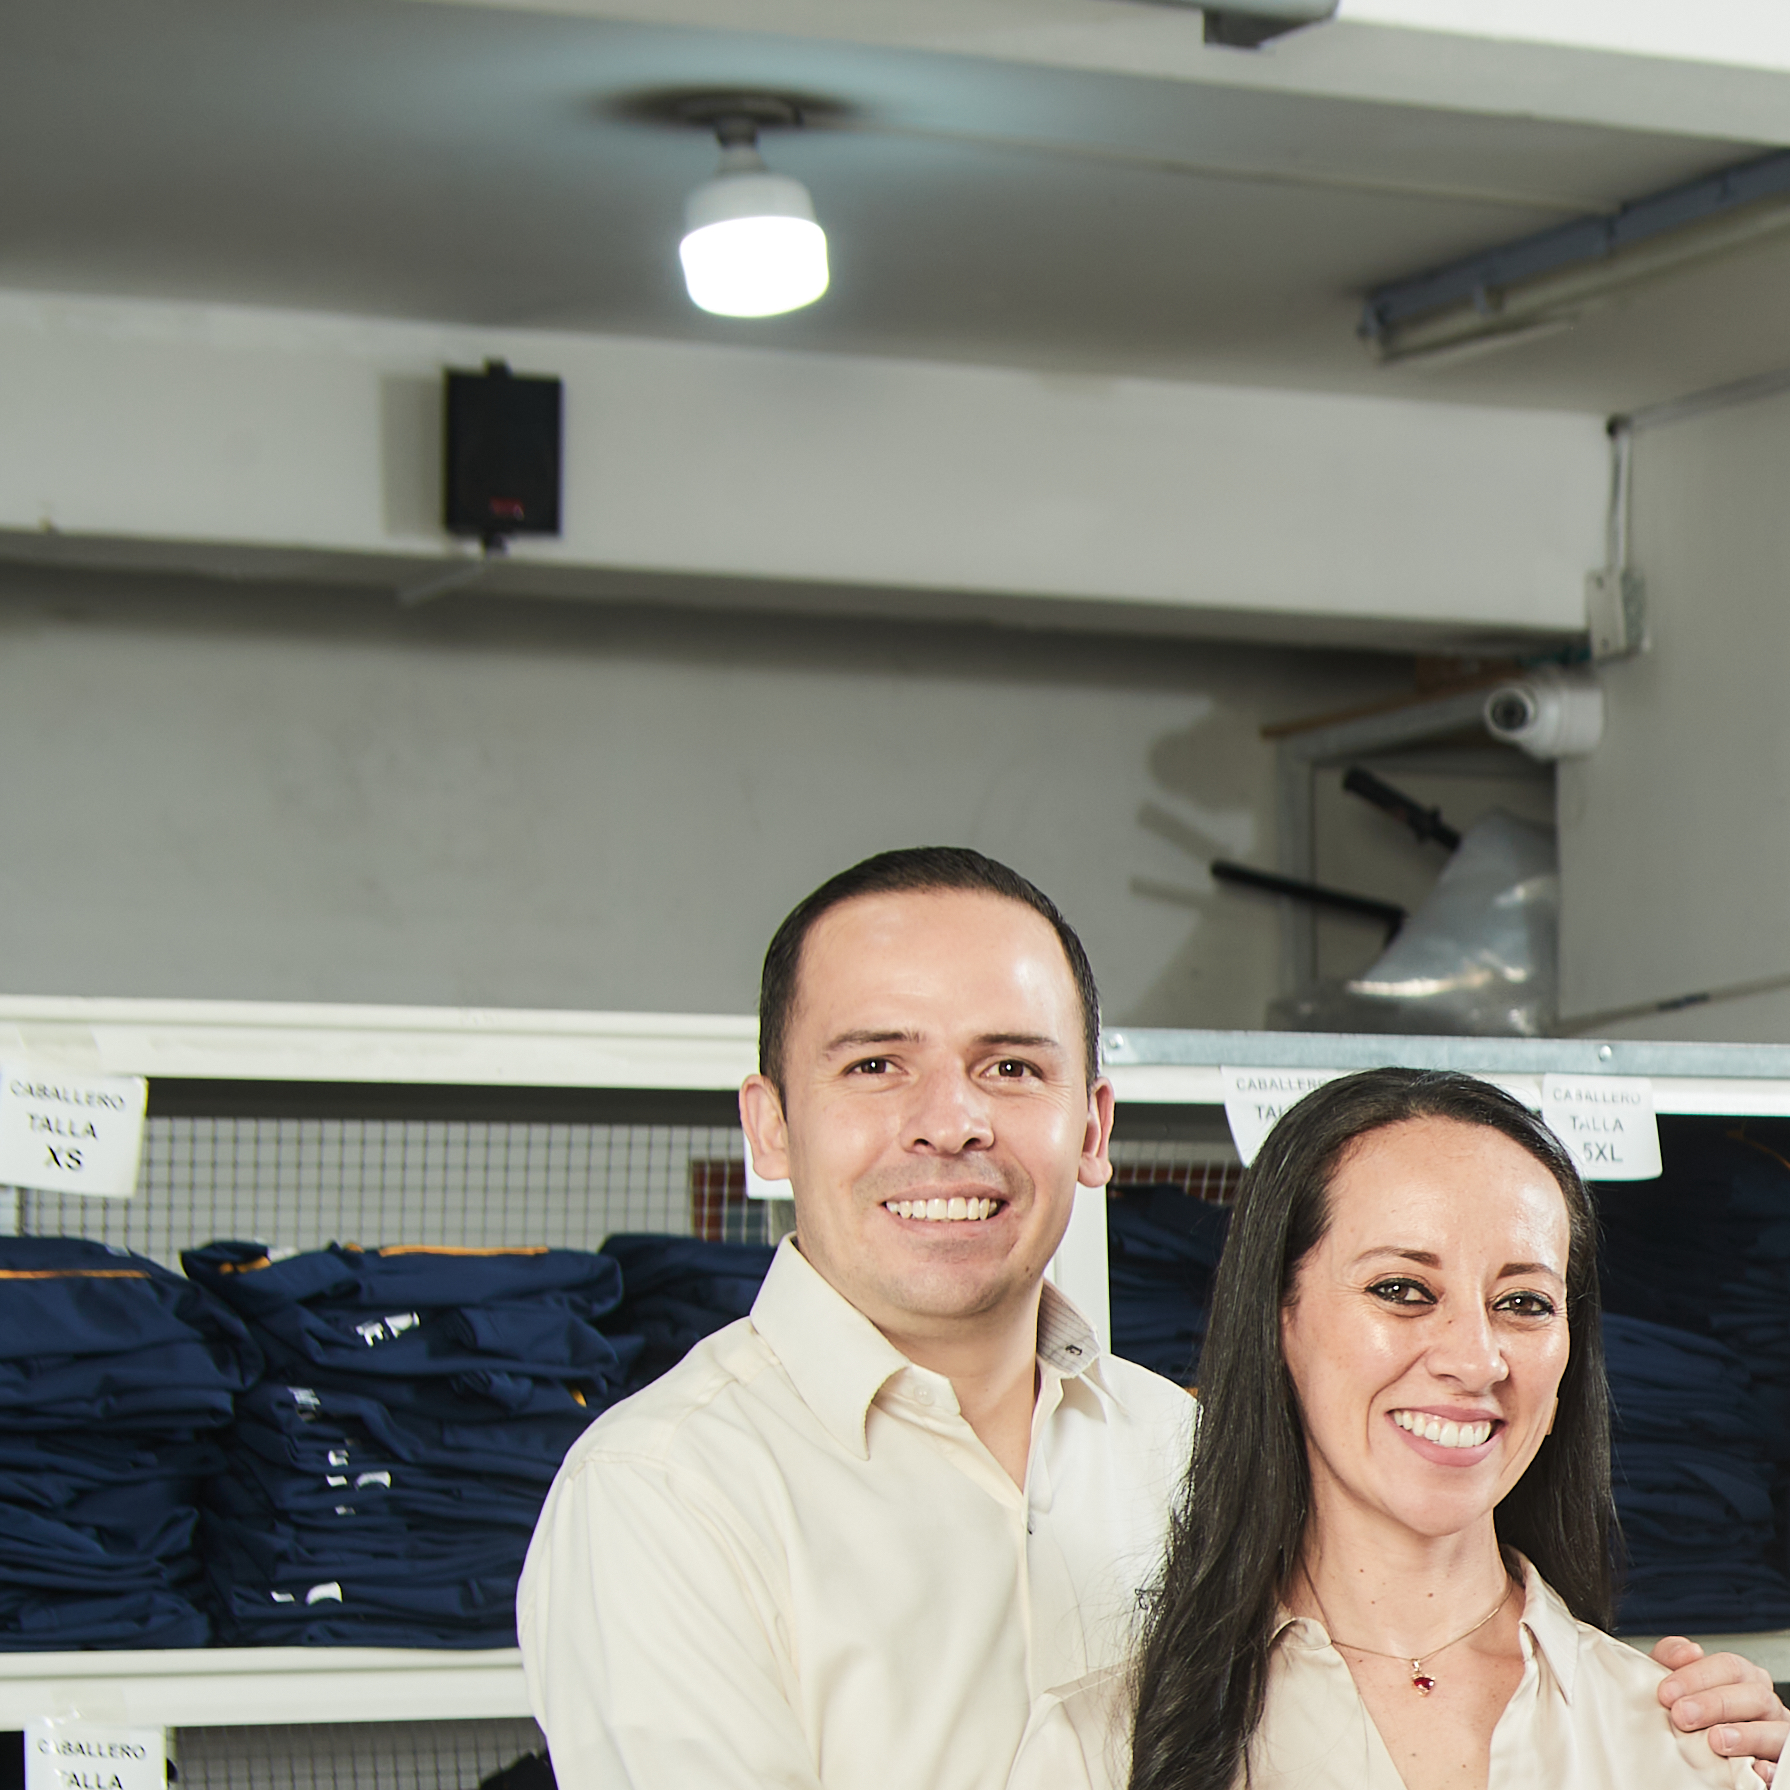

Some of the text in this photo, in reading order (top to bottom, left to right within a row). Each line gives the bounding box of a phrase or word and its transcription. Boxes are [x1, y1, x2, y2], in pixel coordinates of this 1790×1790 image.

[10, 1080, 125, 1112] CABALLERO
[1553, 1088, 1641, 1105] CABALLERO
[27, 1112, 98, 1140] TALLA
[1570, 1115, 1624, 1132] TALLA
[45, 1144, 84, 1171] XS
[1583, 1142, 1624, 1164] 5XL
